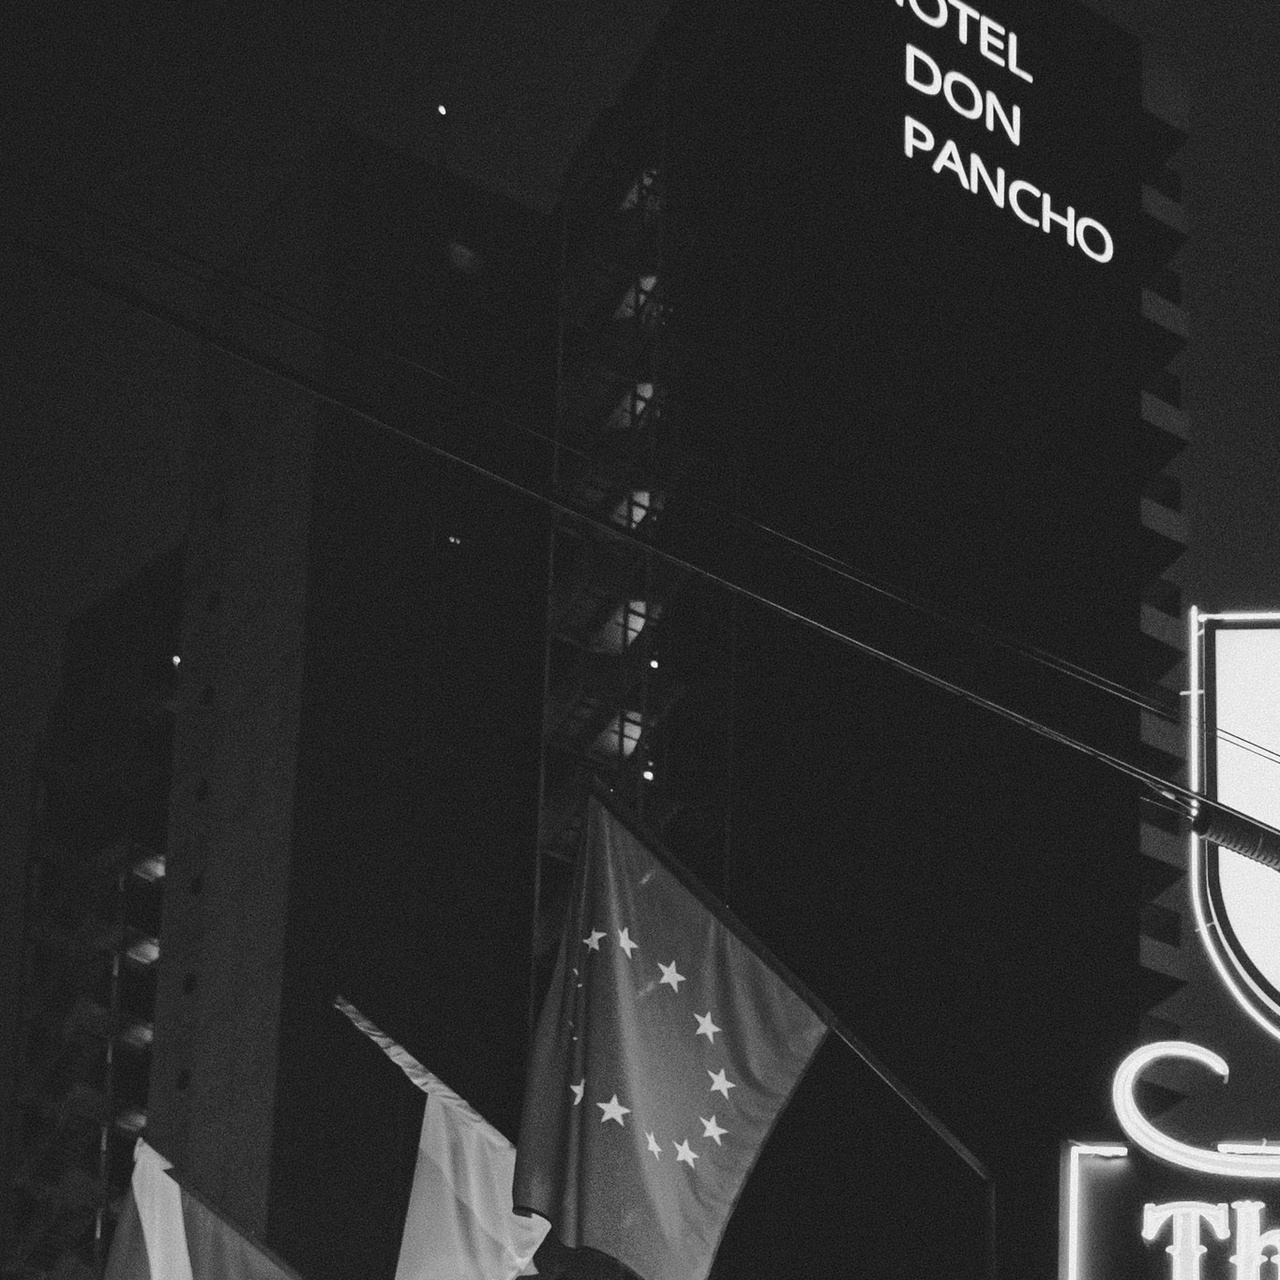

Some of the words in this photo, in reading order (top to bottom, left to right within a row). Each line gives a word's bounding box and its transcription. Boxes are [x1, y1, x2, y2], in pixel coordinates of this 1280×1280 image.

[897, 0, 1034, 84] OTEL
[905, 43, 1021, 146] DON
[904, 115, 1114, 264] PANCHO
